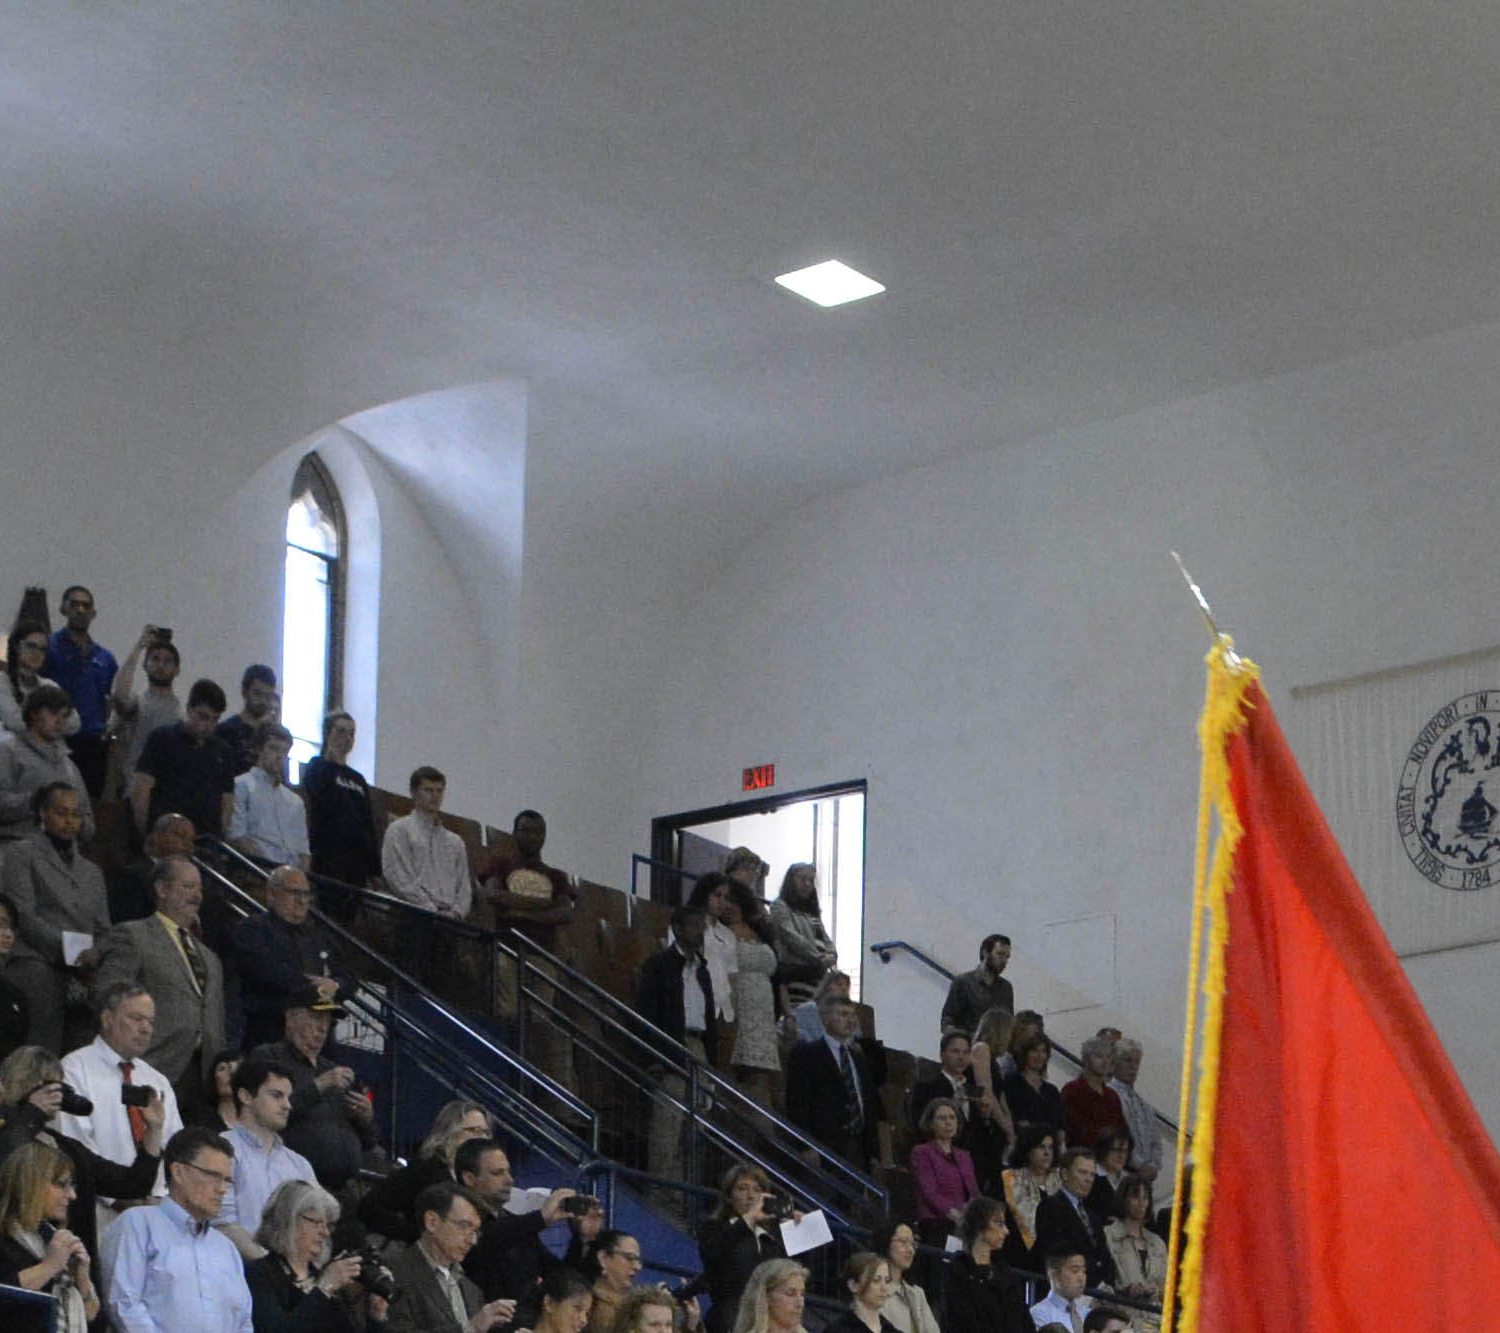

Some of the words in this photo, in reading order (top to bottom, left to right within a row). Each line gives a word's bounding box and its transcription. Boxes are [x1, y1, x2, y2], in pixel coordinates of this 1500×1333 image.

[1409, 702, 1461, 765] NOVIPORT
[1475, 691, 1488, 710] IN
[1461, 867, 1491, 889] 1784
